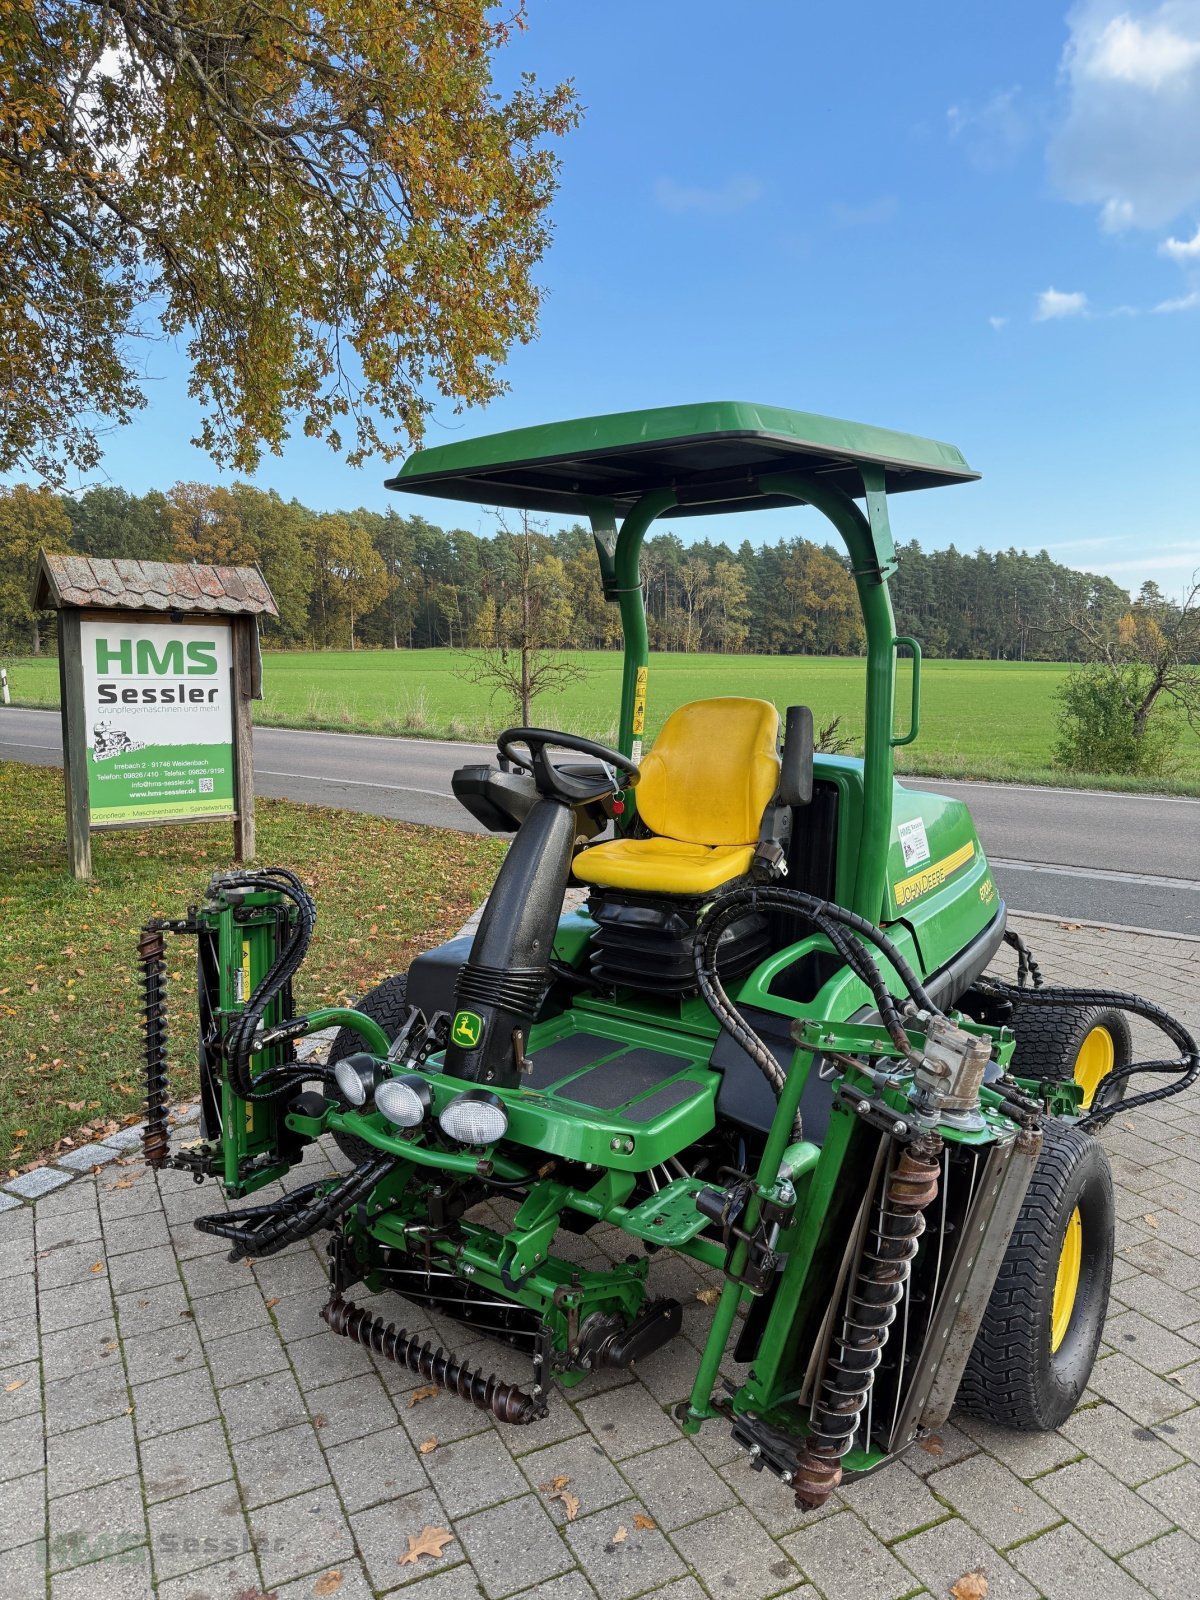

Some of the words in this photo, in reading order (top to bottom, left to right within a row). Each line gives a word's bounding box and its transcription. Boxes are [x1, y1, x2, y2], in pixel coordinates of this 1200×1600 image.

[96, 639, 217, 675] HMS
[98, 684, 218, 704] Sessler
[184, 705, 198, 713] und
[151, 760, 171, 768] 91746
[172, 759, 209, 767] Weidenbach
[97, 773, 122, 781] Telefon:
[129, 788, 197, 798] www.hms-sessler.de
[901, 880, 922, 905] JOHN
